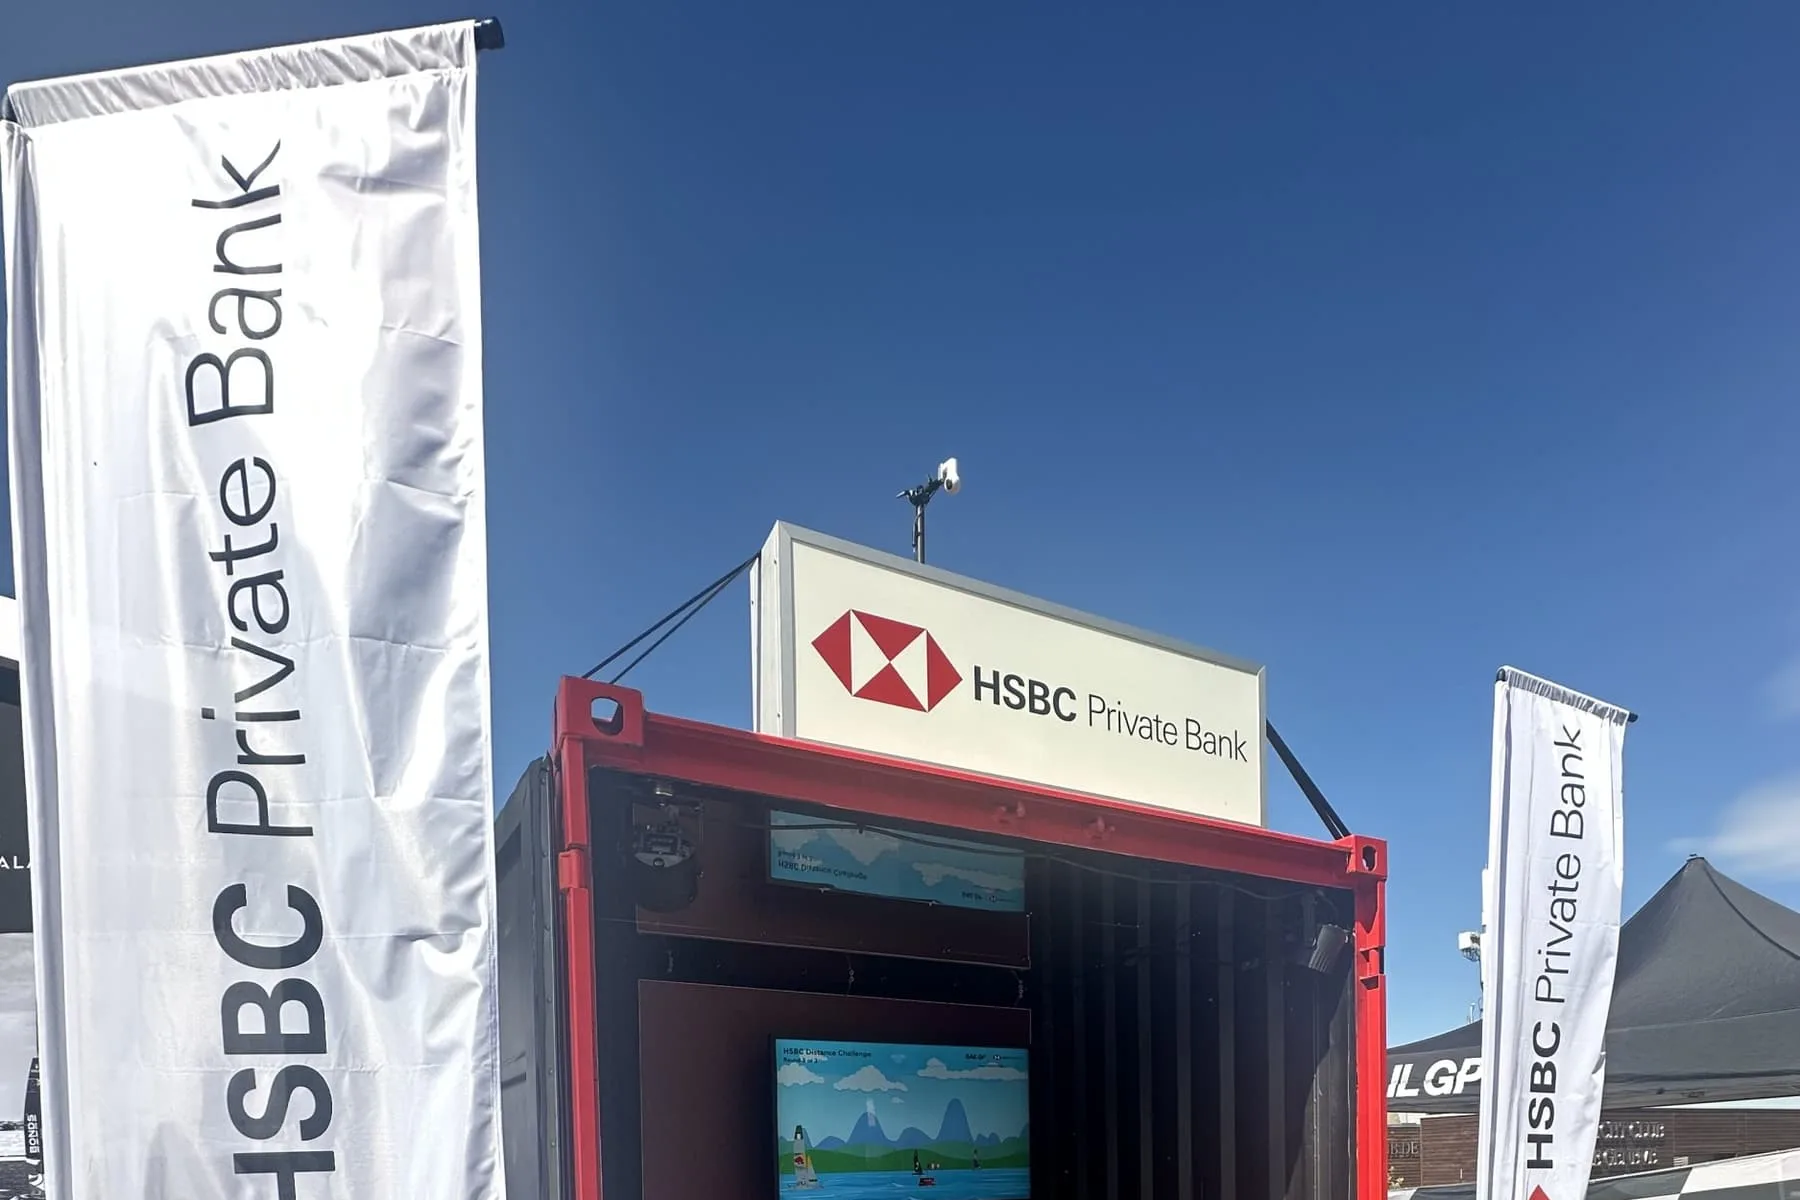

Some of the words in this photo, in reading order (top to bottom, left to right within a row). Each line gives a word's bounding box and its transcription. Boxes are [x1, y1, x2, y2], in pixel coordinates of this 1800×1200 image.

[185, 138, 283, 427] Bank
[201, 454, 314, 837] Private
[973, 664, 1077, 722] HSBC
[1088, 693, 1178, 746] Private
[1185, 717, 1248, 763] Bank
[1549, 723, 1586, 840] Bank
[1535, 852, 1582, 1003] Private
[783, 1047, 804, 1056] HSBC
[805, 1048, 837, 1057] Distance
[838, 1049, 872, 1058] Challenge
[1385, 1062, 1420, 1098] IL
[1526, 1020, 1561, 1169] HSBC
[27, 1114, 40, 1153] BONDS
